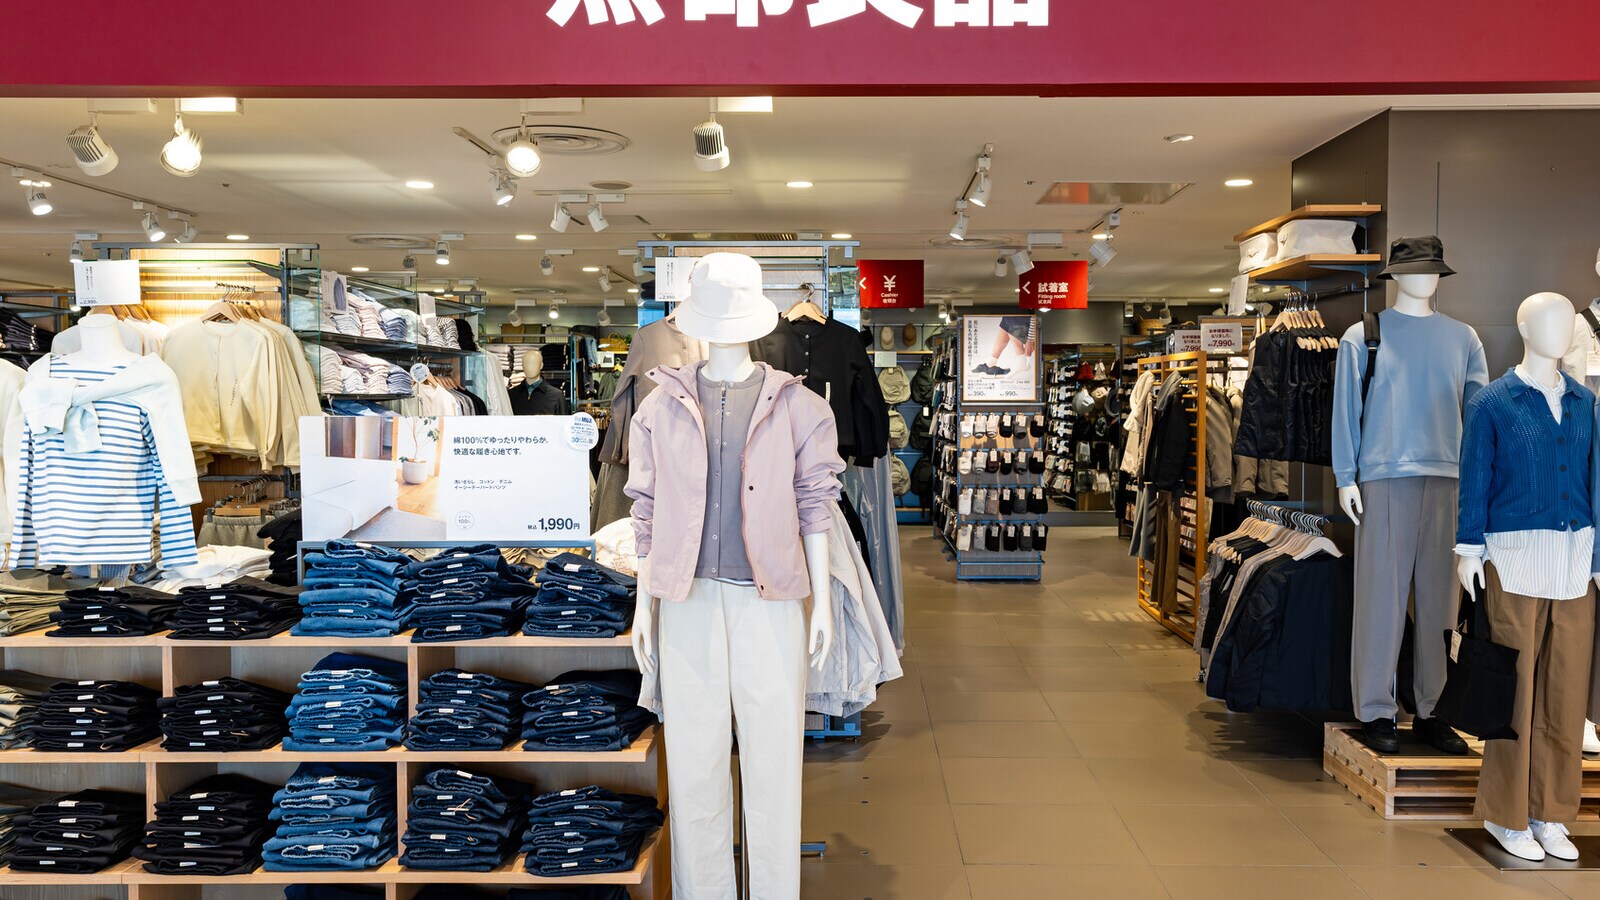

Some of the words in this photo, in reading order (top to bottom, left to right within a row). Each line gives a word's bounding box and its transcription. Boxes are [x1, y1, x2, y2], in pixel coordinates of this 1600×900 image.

[1038, 282, 1069, 293] 試着室
[453, 447, 522, 456] 快適な履き心地です。
